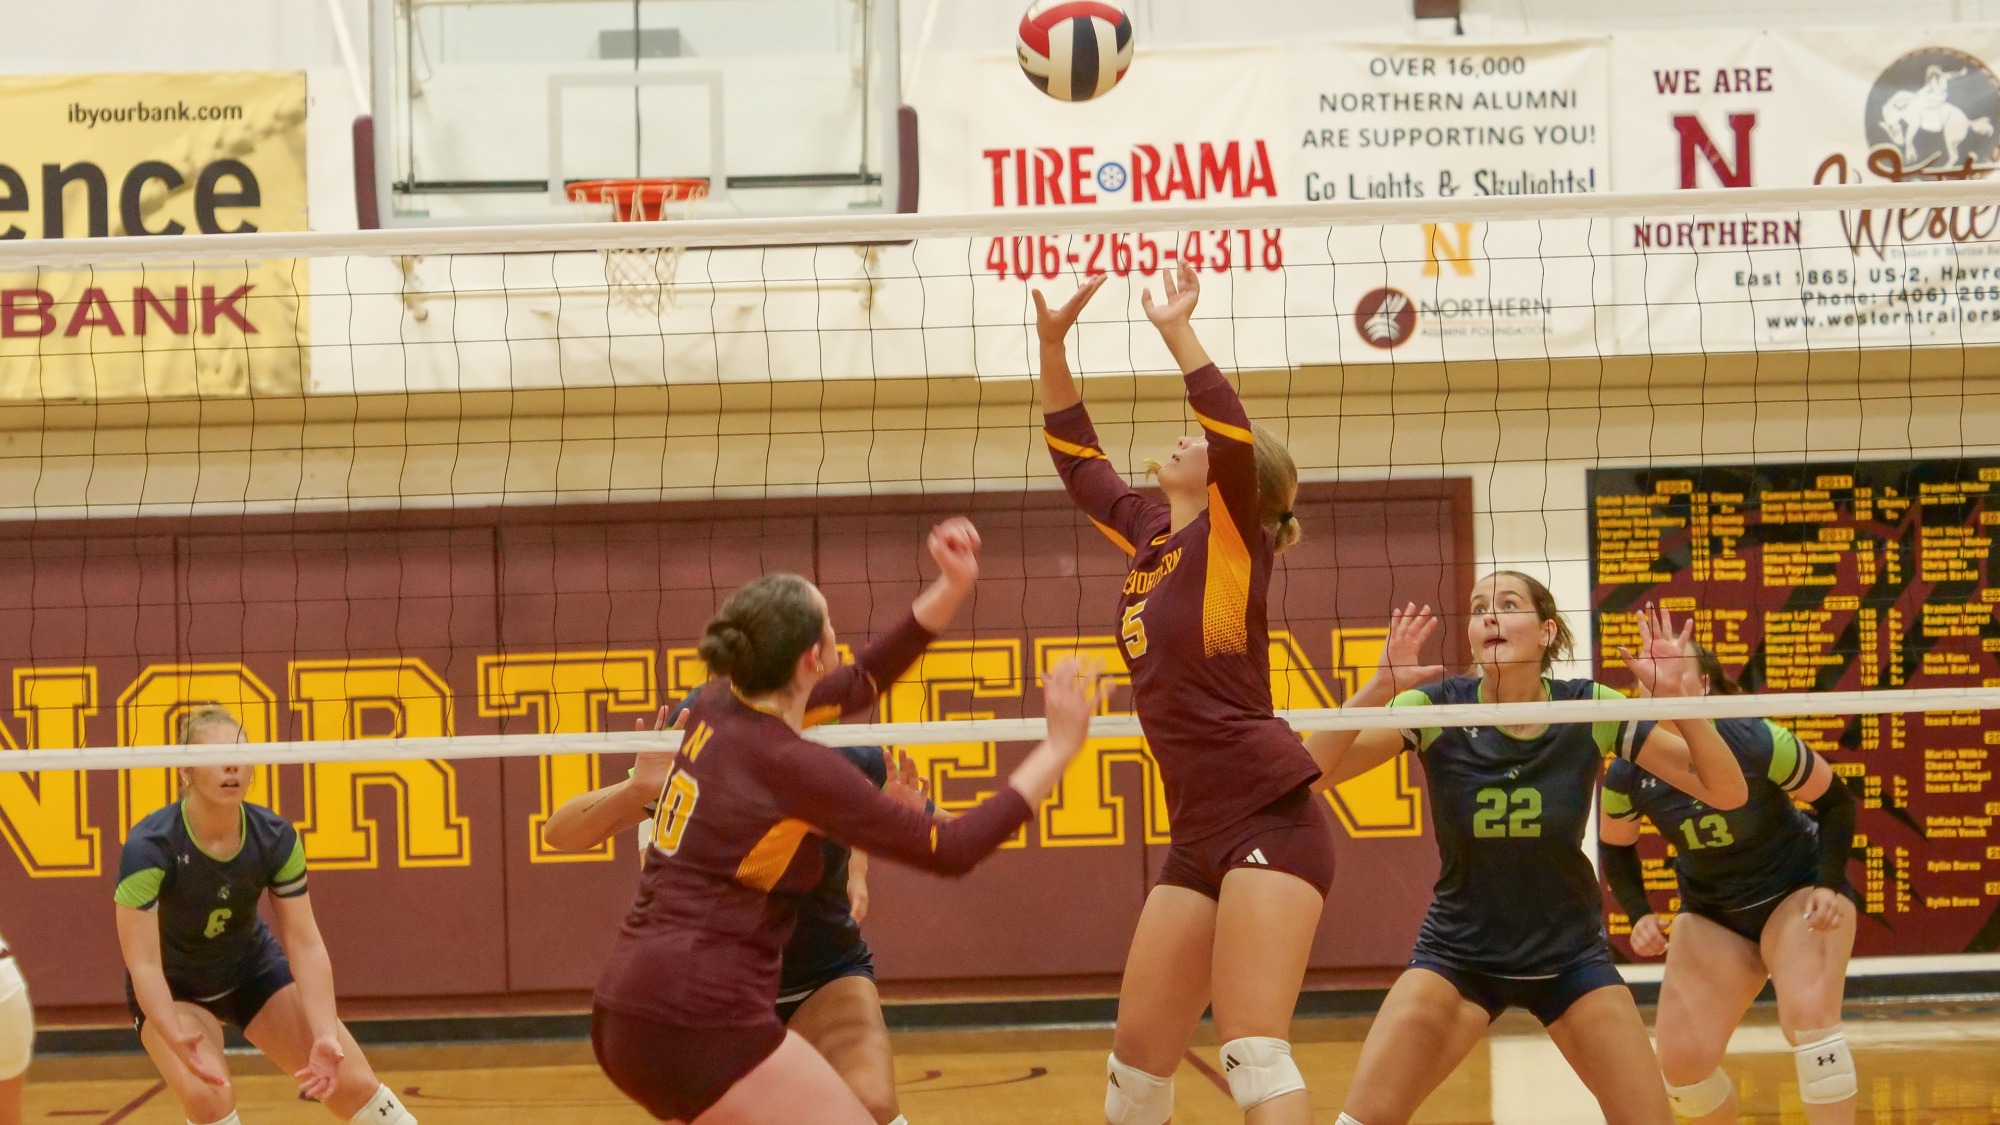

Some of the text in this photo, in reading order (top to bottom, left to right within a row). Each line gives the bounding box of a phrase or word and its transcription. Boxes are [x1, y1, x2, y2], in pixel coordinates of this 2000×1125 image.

[1369, 56, 1526, 79] OVER 16,000
[1654, 68, 1773, 94] WE ARE
[68, 101, 243, 128] ibyourbank.com
[1318, 89, 1577, 113] NORTHERN ALUMNI
[1302, 124, 1596, 148] ARE SUPPORTING YOU!
[1673, 113, 1756, 189] N
[1305, 171, 1336, 201] Go
[1633, 219, 1802, 249] NORTHERN
[986, 228, 1284, 281] 406-265-4318
[1420, 222, 1475, 277] N
[1735, 271, 1782, 287] East
[0, 284, 260, 338] BANK
[1420, 297, 1554, 319] NORTHERN
[1803, 291, 1877, 308] Phone:
[1122, 597, 1148, 660] 5
[0, 627, 1423, 878] NORTERN
[1473, 787, 1542, 838] 22
[1679, 813, 1735, 850] 13
[204, 908, 232, 939] 6
